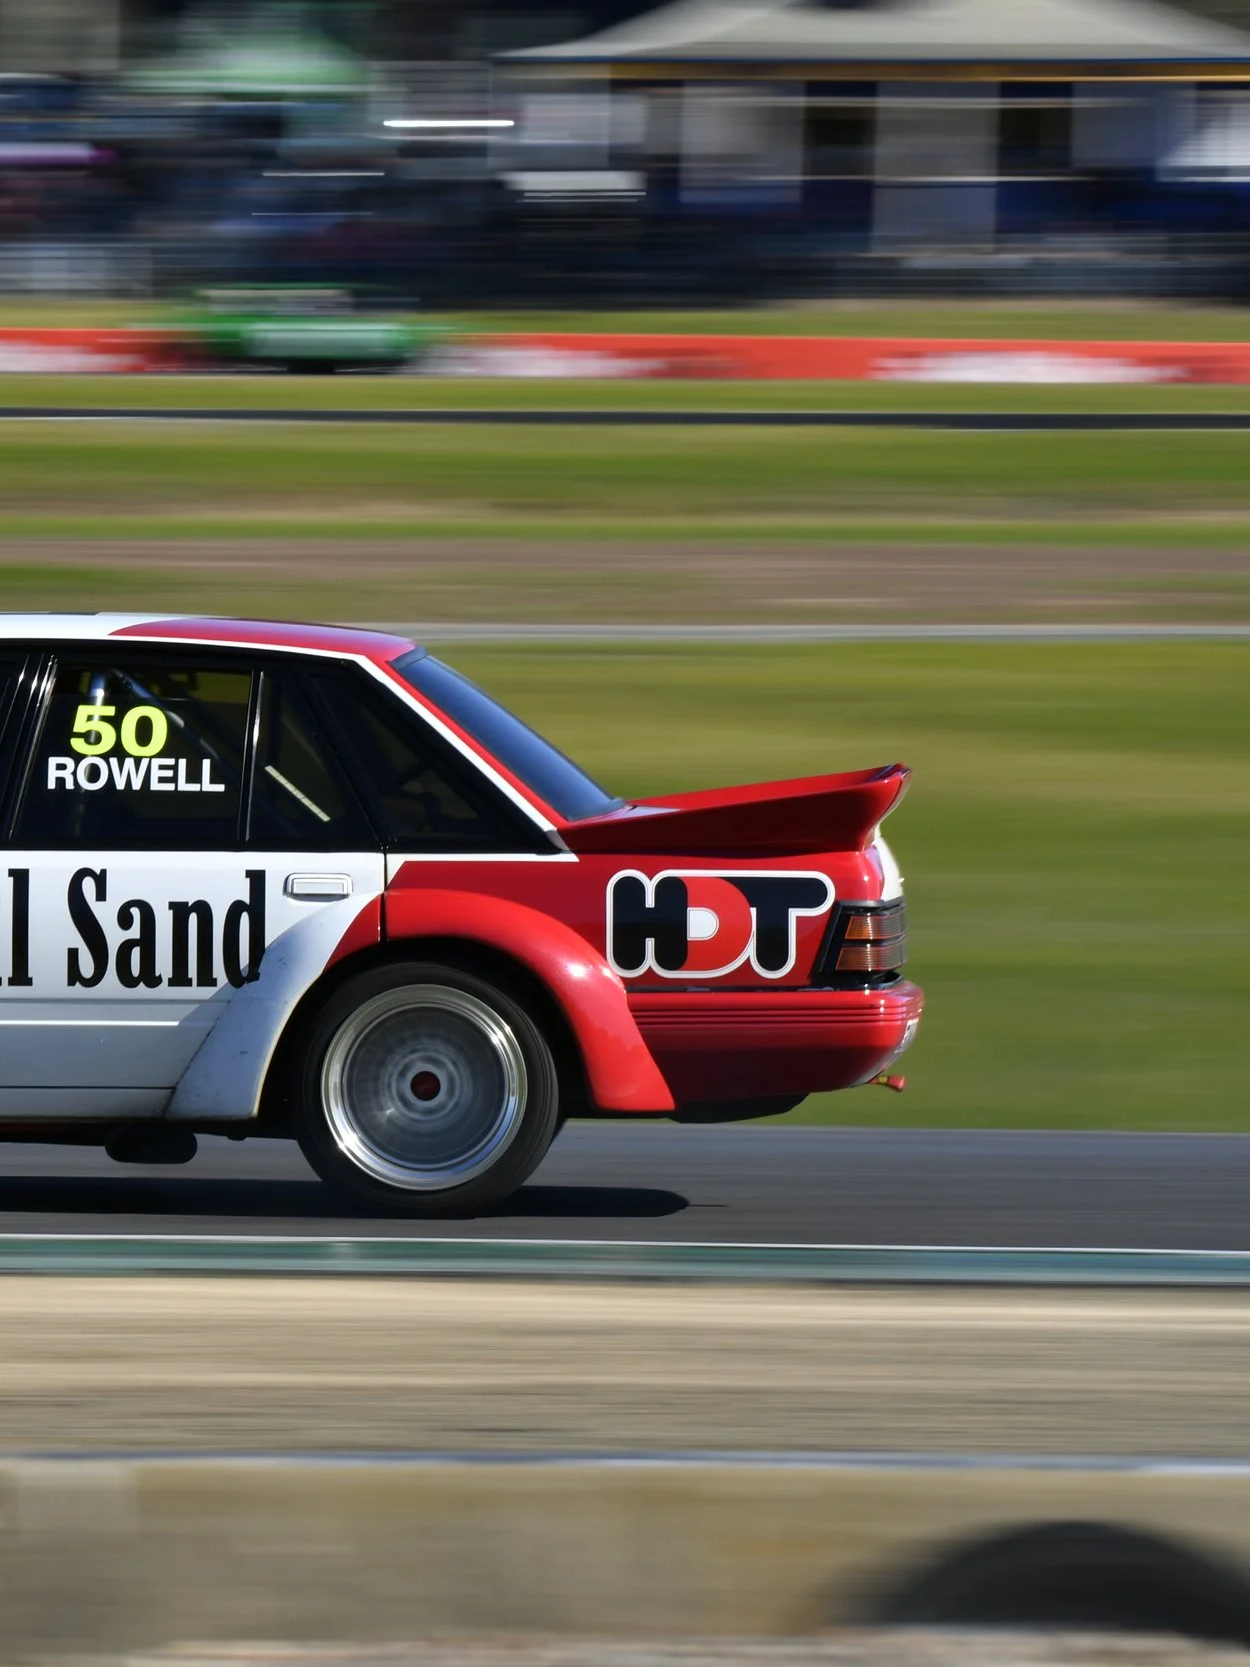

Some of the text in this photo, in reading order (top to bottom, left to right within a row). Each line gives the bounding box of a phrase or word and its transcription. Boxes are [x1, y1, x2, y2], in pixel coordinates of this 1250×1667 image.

[70, 705, 168, 756] 50
[47, 757, 225, 792] ROWELL
[67, 868, 266, 988] Sand
[606, 869, 835, 978] HDT
